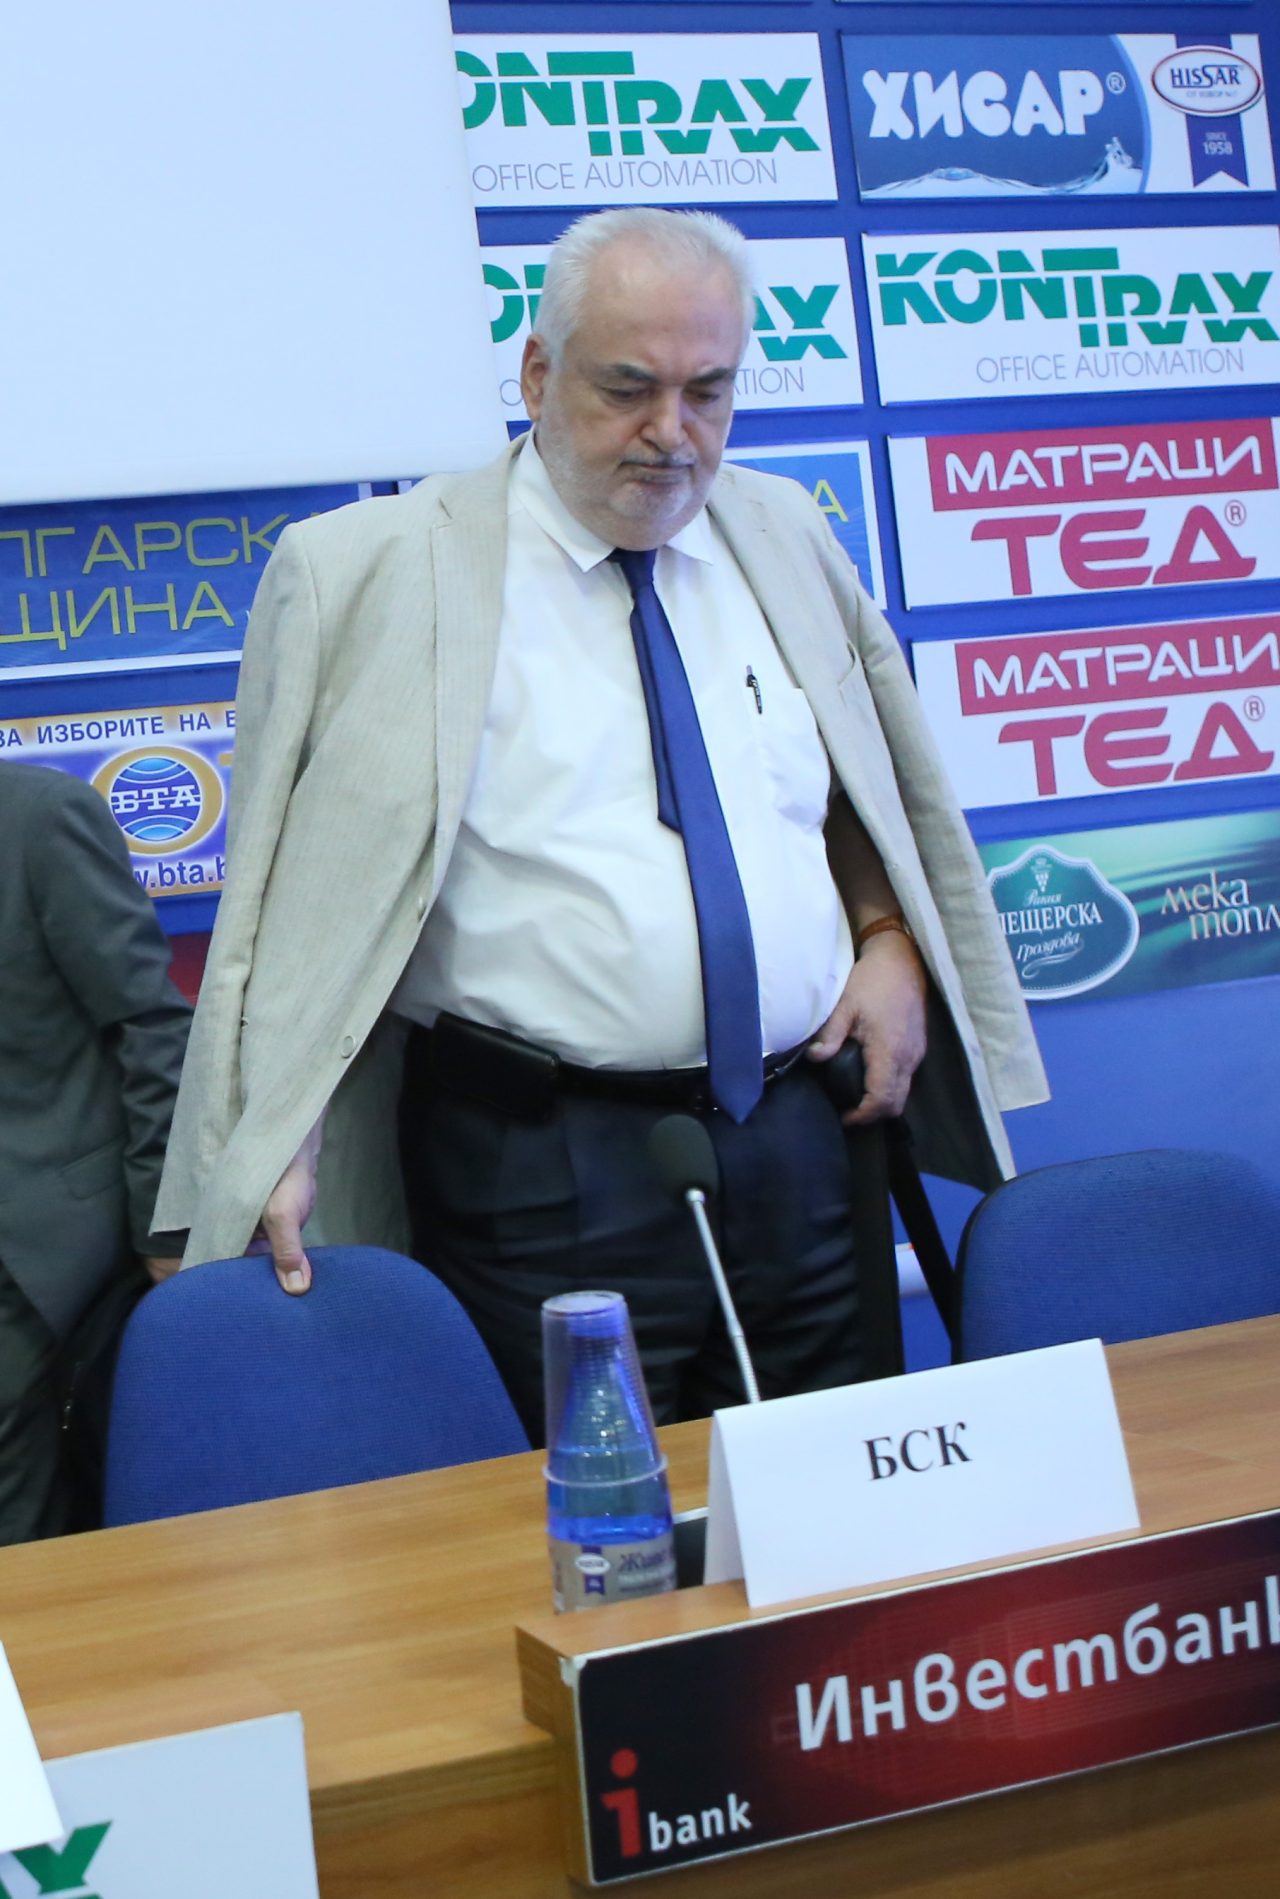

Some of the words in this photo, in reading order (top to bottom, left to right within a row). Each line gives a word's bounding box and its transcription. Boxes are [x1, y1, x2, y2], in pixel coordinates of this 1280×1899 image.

[862, 69, 1104, 140] ХИСАР
[1169, 64, 1241, 88] HISSAR
[472, 163, 575, 192] OFFICE
[584, 158, 778, 189] AUTOMATION
[875, 247, 1280, 348] KONTRAX
[976, 353, 1067, 384] OFFICE
[1074, 348, 1245, 379] AUTOMATION
[945, 435, 1263, 494] МАТРАЦИ
[971, 504, 1257, 596] ТЕД
[37, 715, 164, 745] ИЗБОРИТЕ
[179, 711, 211, 732] НА
[998, 701, 1275, 796] ТЕД
[111, 784, 200, 814] БТА
[862, 1421, 973, 1481] БСК
